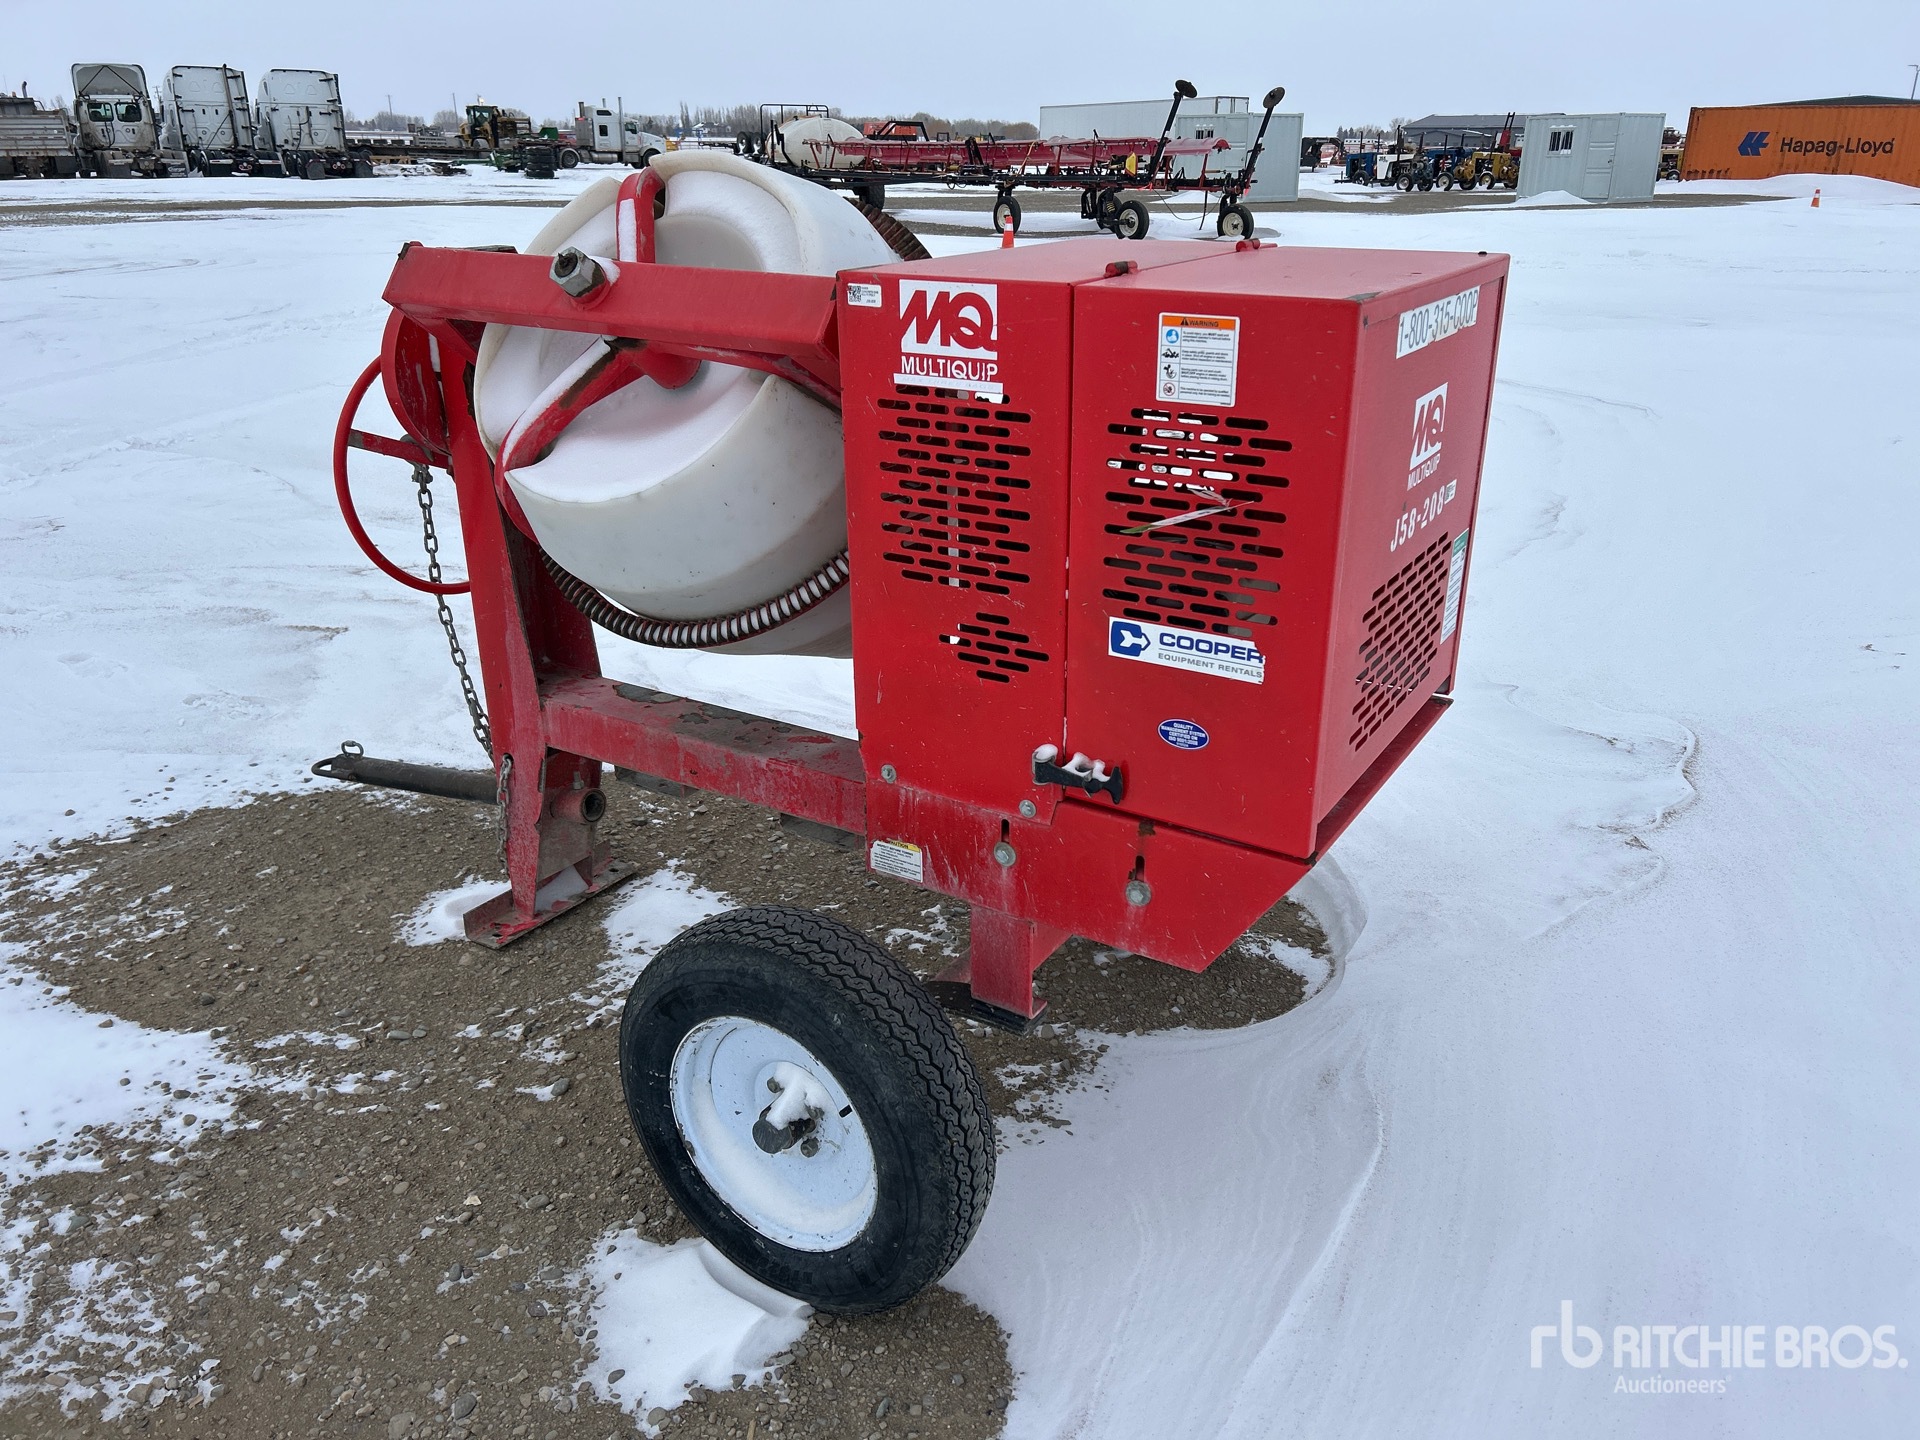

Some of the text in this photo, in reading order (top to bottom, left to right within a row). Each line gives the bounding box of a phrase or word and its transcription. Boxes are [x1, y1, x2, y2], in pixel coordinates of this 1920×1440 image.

[1780, 136, 1895, 157] Hapag-Lloyd
[900, 289, 998, 352] MQ
[1189, 319, 1219, 328] WARNING
[1399, 289, 1479, 353] 1-800-315-COOP
[901, 355, 998, 381] MULTIQUIP
[1407, 453, 1441, 491] MULTIQUIP
[1390, 485, 1445, 553] J58-208
[1158, 652, 1214, 669] EQUIPMENT
[1159, 632, 1264, 664] COOPER
[1218, 663, 1263, 679] RENTALS
[1173, 722, 1194, 730] QUALITY
